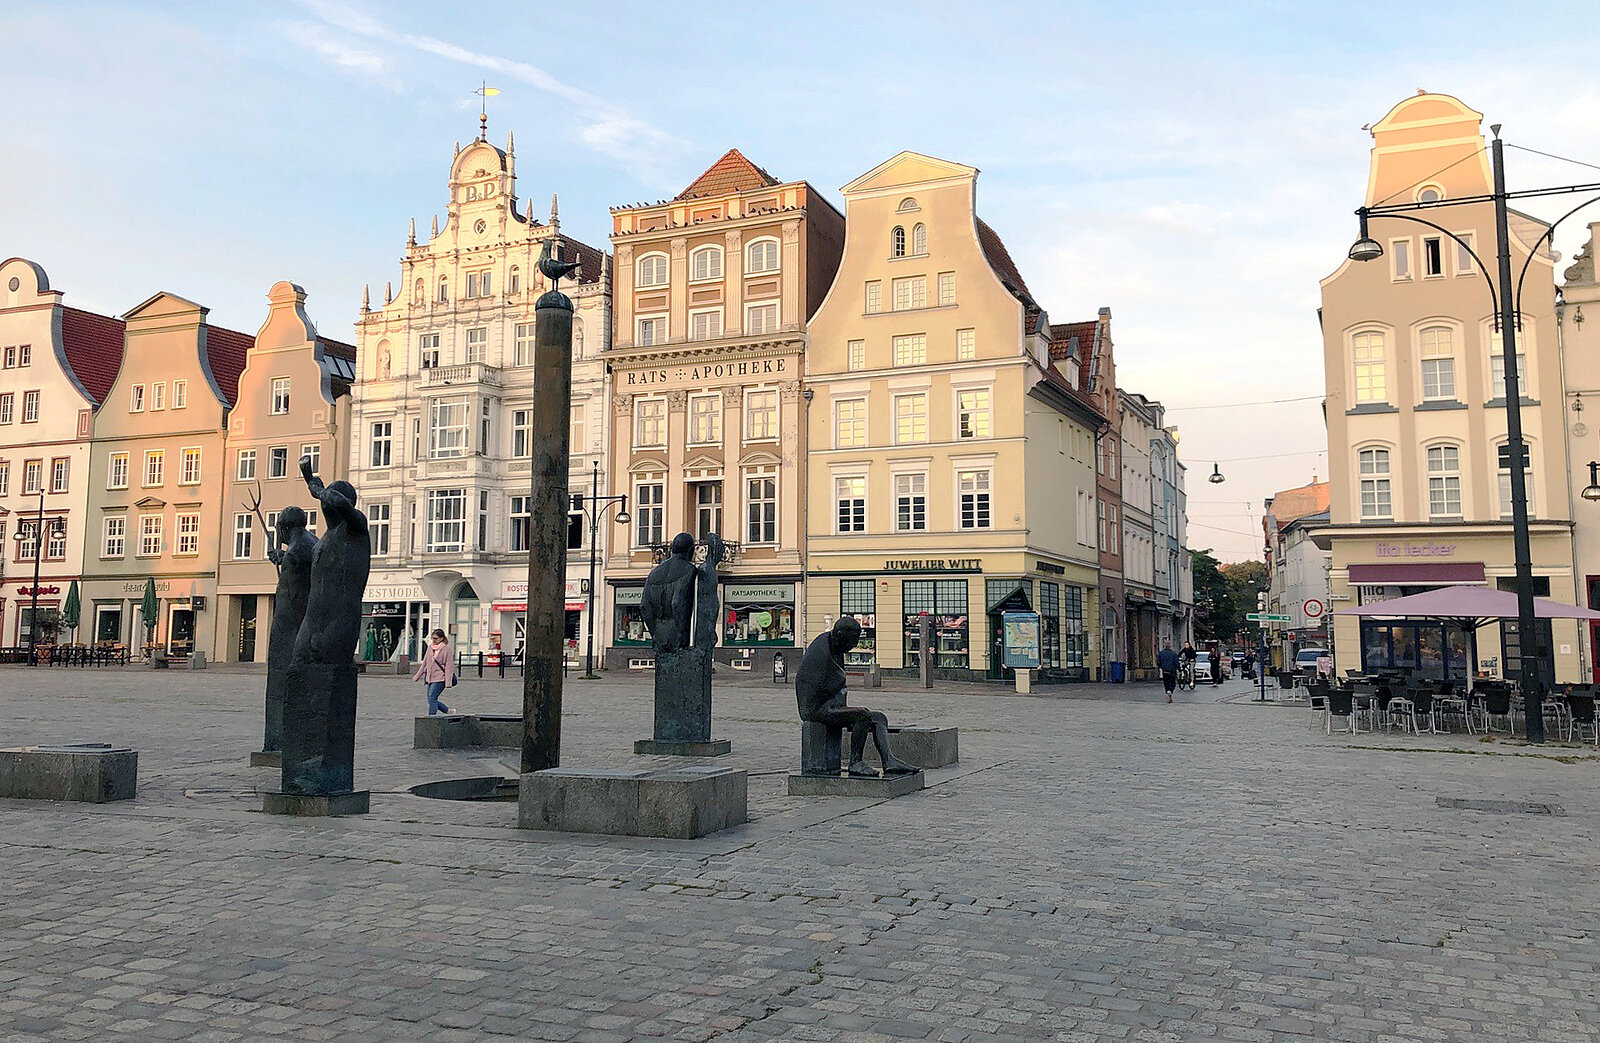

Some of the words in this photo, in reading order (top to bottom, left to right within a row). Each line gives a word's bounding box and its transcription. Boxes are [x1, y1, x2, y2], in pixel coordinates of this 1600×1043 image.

[627, 370, 667, 385] RATS
[691, 358, 786, 380] APOTHEKE
[1376, 542, 1400, 557] lila
[1404, 542, 1456, 556] lecker
[883, 560, 945, 570] JUWELIER
[948, 559, 982, 569] WITT
[365, 587, 419, 598] ESTMODE
